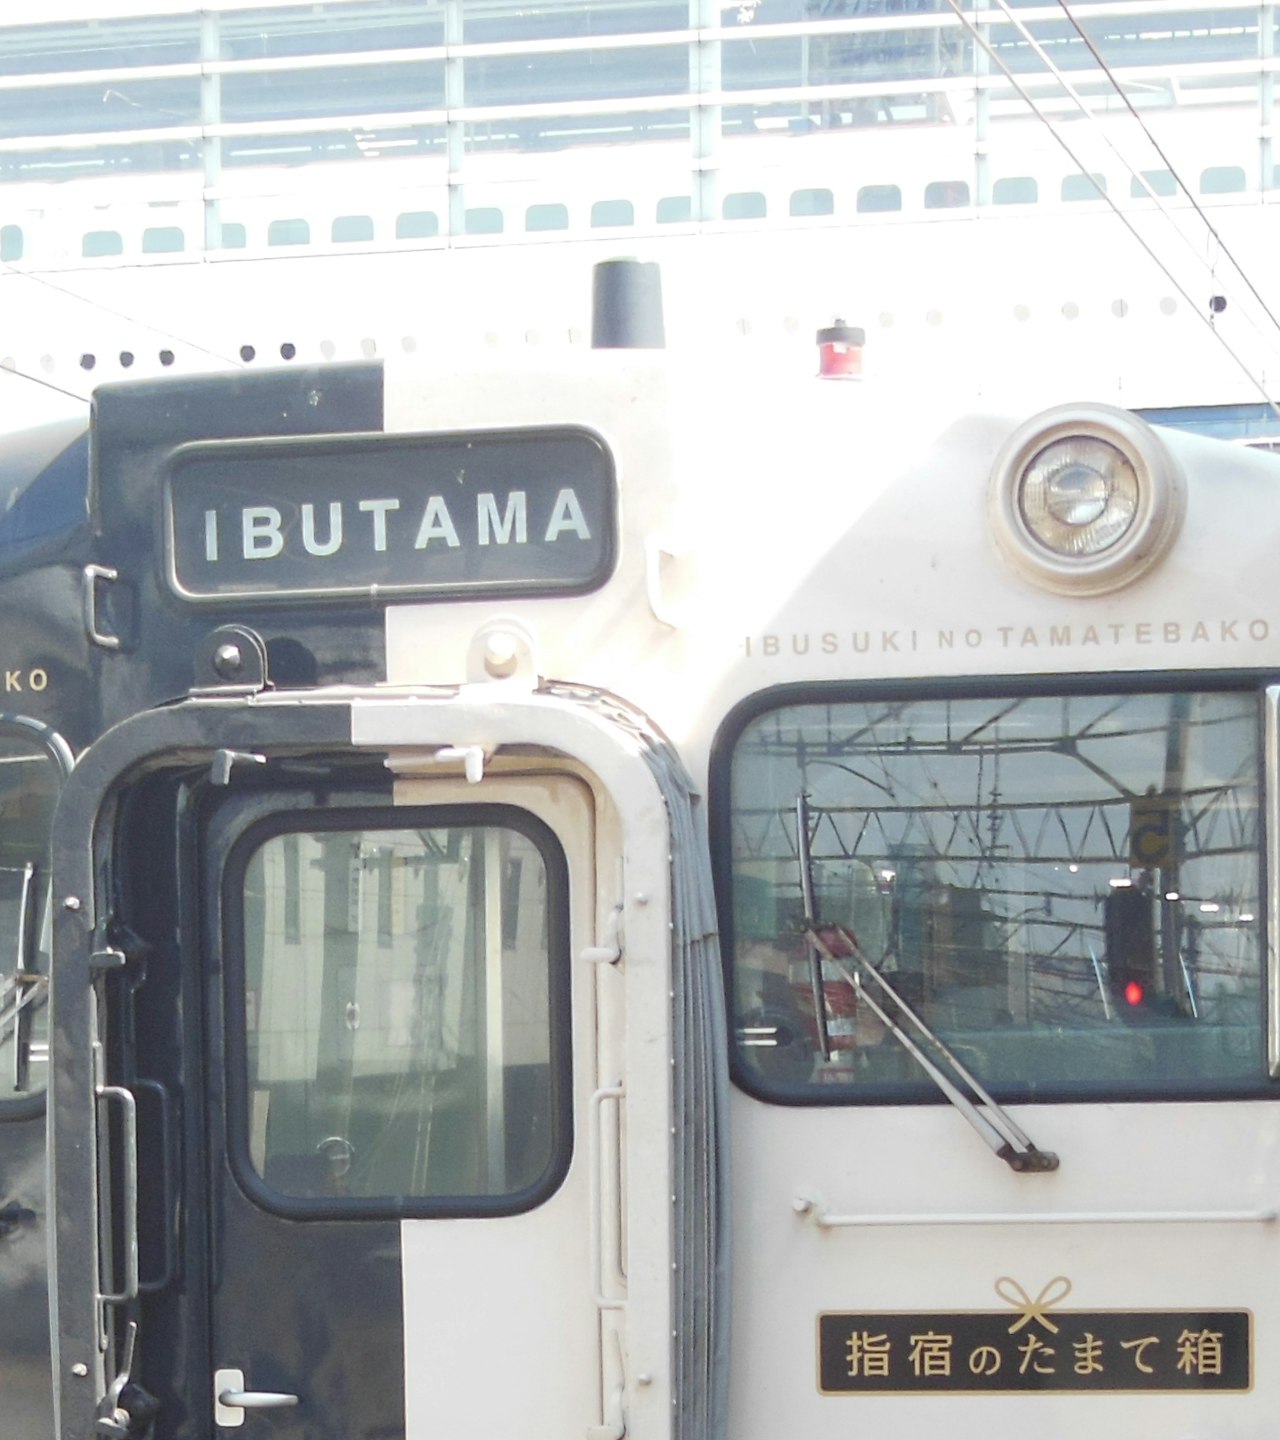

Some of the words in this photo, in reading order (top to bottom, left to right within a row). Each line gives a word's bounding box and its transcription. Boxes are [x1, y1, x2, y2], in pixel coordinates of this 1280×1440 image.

[204, 488, 591, 561] IBUTAMA
[744, 630, 919, 657] IBUSUKI
[939, 630, 982, 648] NO
[999, 618, 1272, 648] TAMATEBAKO
[846, 1328, 1223, 1377] 指宿のたまて箱
